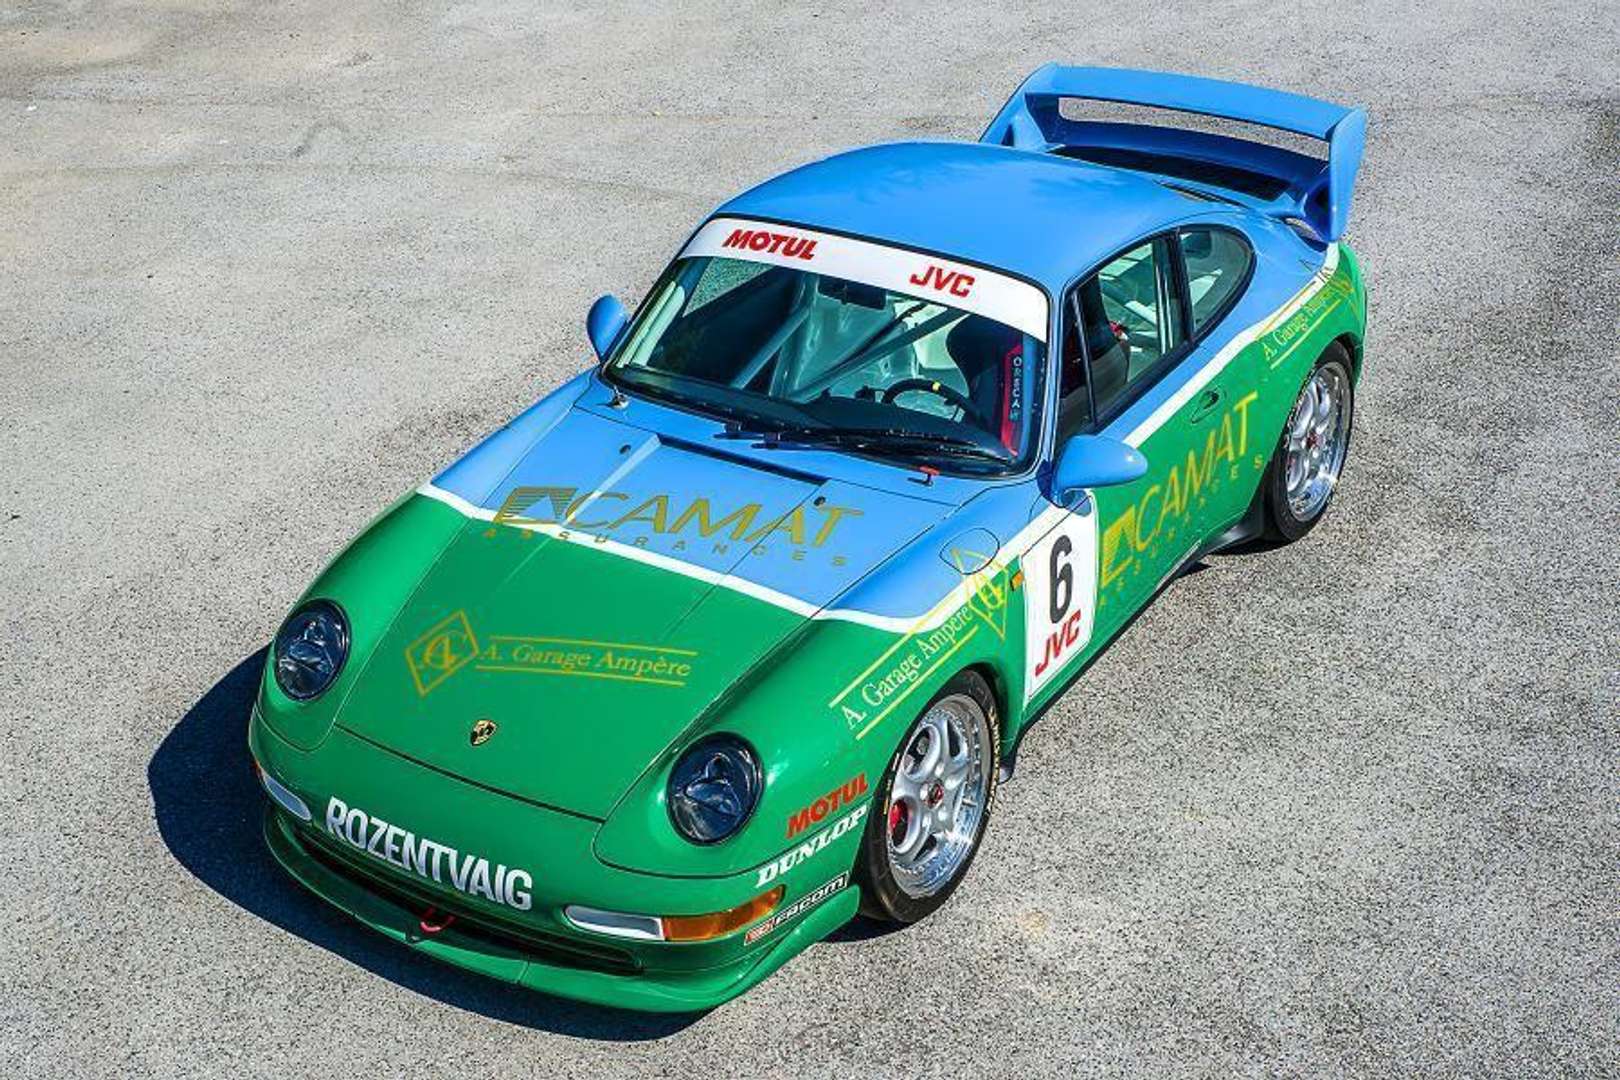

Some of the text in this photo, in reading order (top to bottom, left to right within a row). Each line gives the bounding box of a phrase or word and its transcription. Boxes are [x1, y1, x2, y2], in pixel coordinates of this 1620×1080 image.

[722, 229, 818, 260] MOTUL
[910, 266, 975, 298] JVC
[1136, 391, 1259, 552] CAMAT
[565, 491, 864, 547] CAMAT
[1049, 534, 1073, 624] 6
[512, 644, 591, 673] Garage
[595, 650, 692, 680] Ampère
[1035, 609, 1081, 677] JVC
[861, 652, 922, 707] Garage
[785, 772, 869, 840] MOTUL
[326, 796, 533, 911] ROZENTVAIG
[755, 804, 869, 888] DUNLOP
